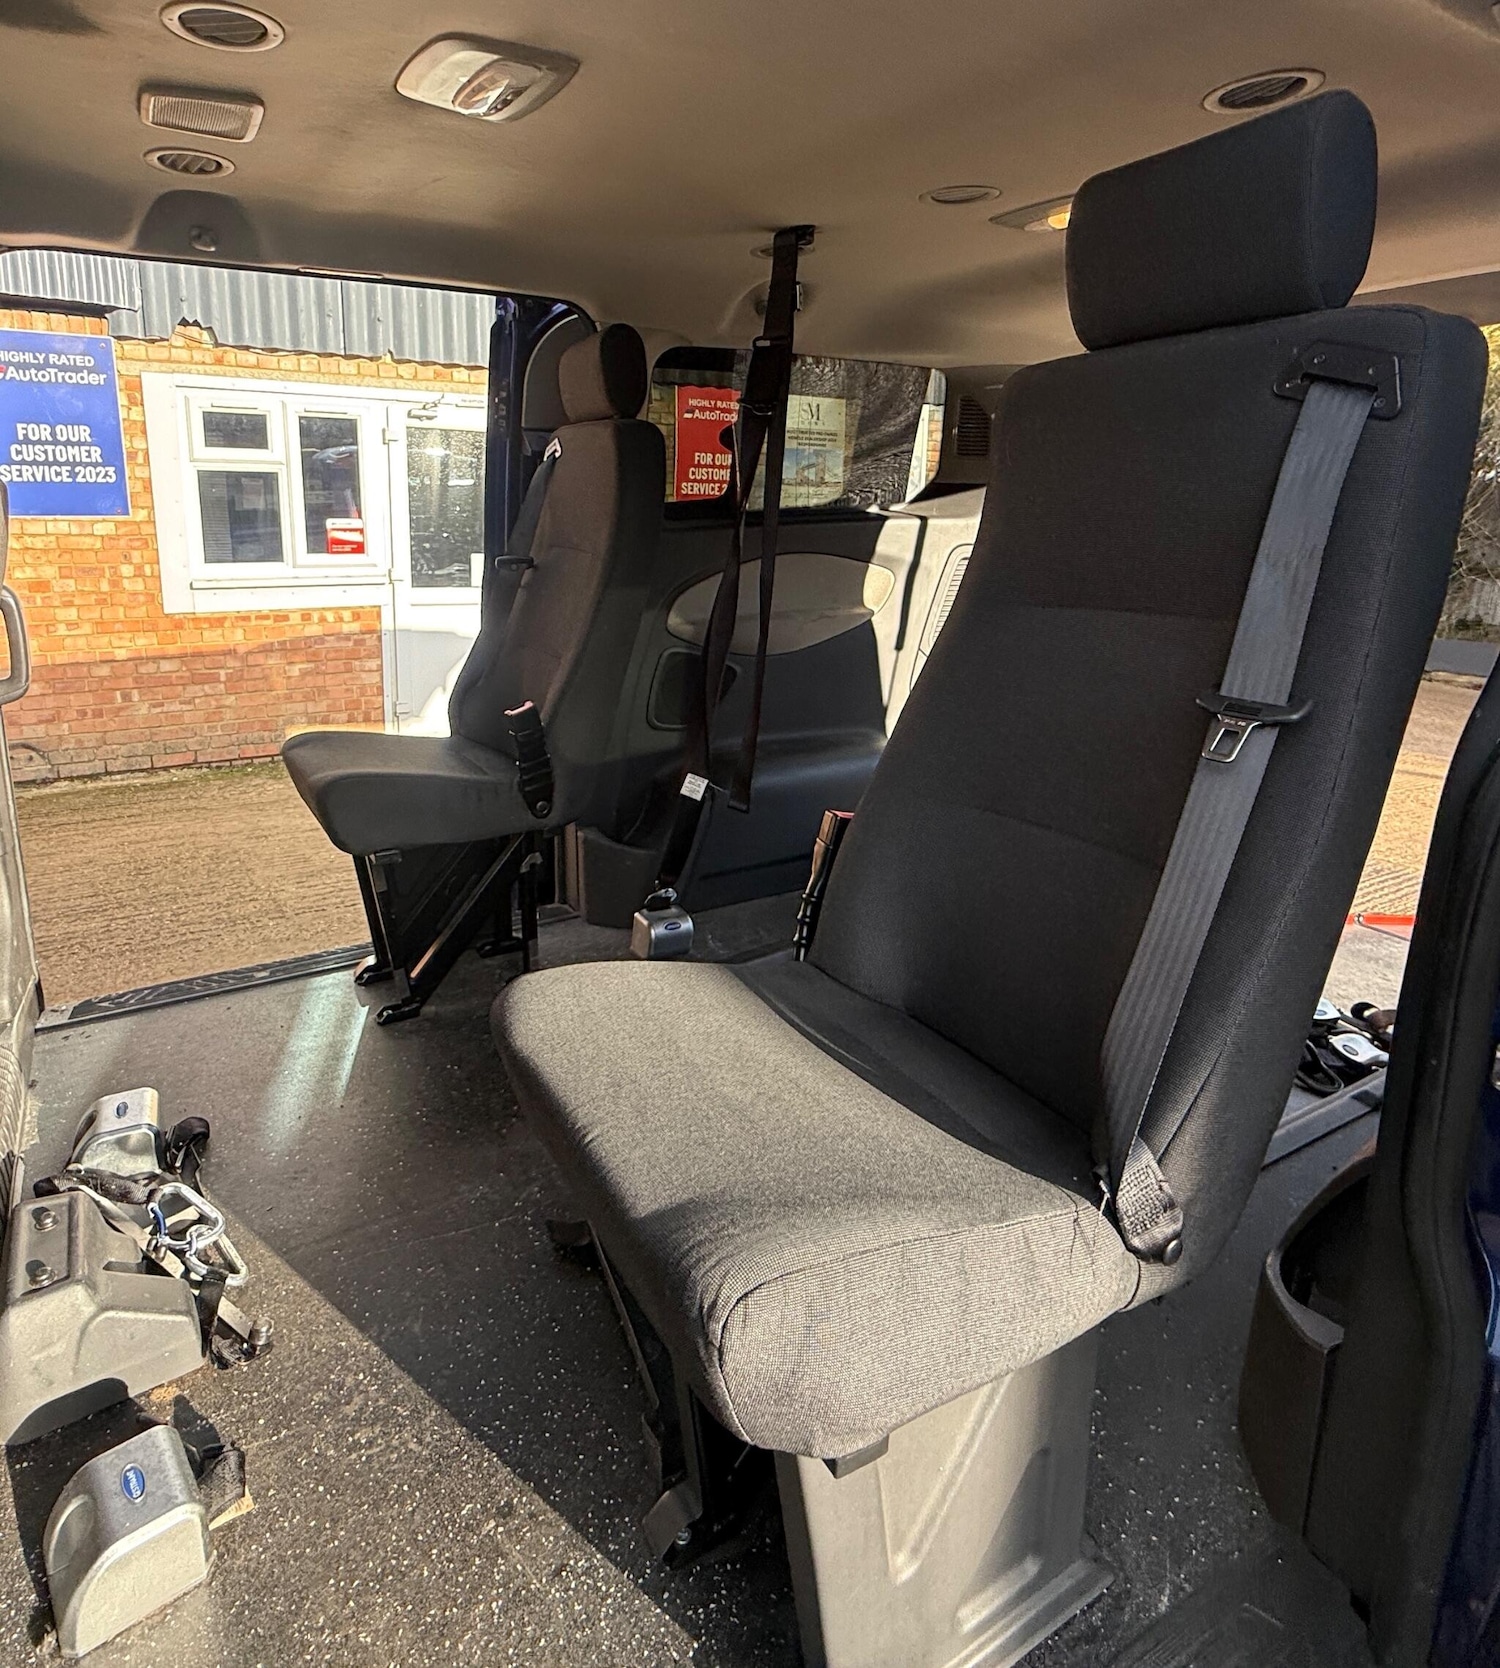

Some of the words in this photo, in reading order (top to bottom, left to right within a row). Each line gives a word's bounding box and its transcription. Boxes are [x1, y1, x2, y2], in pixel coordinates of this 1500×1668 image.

[48, 353, 94, 367] RATED
[5, 366, 107, 385] AutoTrader
[688, 398, 715, 408] HIGHLY
[693, 409, 738, 423] AutoTrad
[16, 423, 53, 441] FOR
[55, 424, 92, 442] OUR
[10, 444, 103, 463] CUSTOMER
[694, 452, 713, 465] FOR
[0, 464, 73, 483] SERVICE
[74, 466, 117, 483] 2023
[689, 467, 731, 481] CUSTOME
[681, 482, 720, 496] SERVICE
